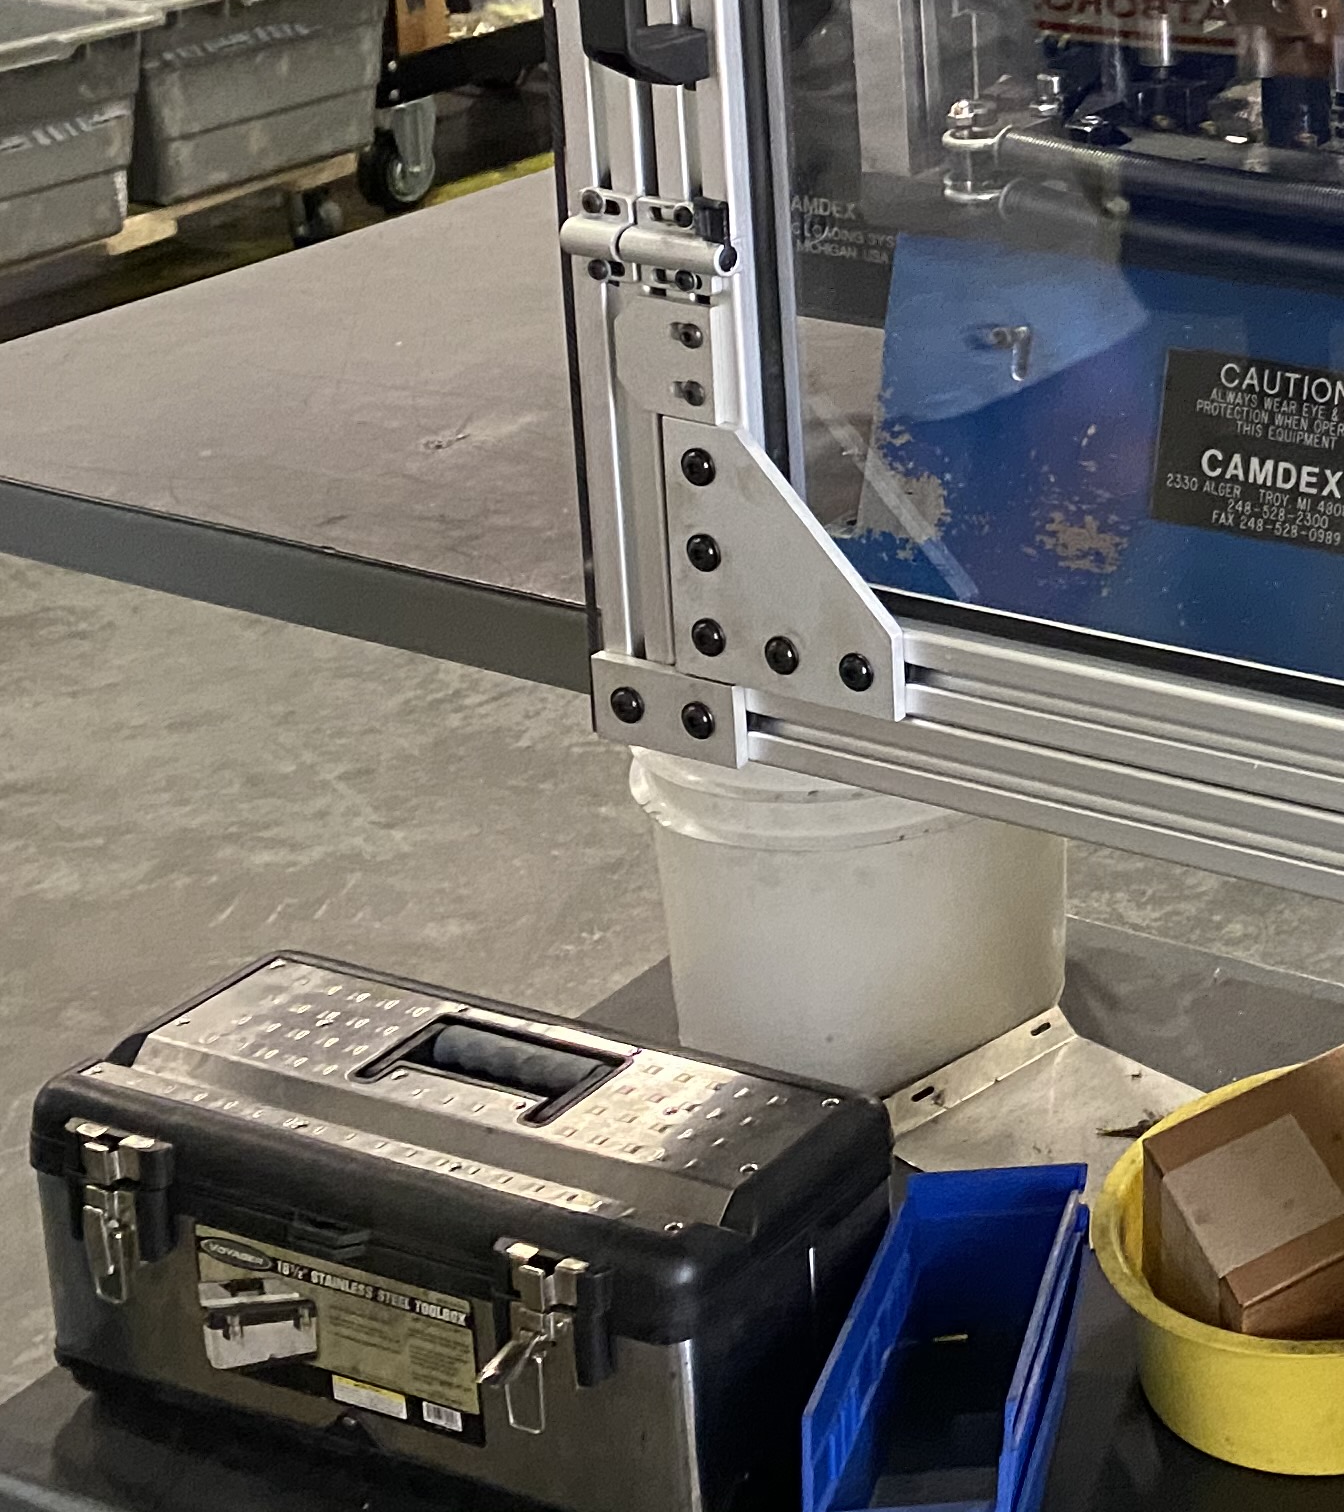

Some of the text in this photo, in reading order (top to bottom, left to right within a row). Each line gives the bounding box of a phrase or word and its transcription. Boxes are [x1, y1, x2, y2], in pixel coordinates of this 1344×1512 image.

[791, 194, 856, 220] AMDEX
[1196, 399, 1269, 425] PROTECTION
[1274, 411, 1309, 432] WHEN
[1209, 387, 1258, 409] ALWAYS
[1263, 394, 1296, 415] WEAR
[1301, 401, 1326, 420] EYE
[1331, 406, 1340, 423] &
[1236, 420, 1337, 451] THIS EQUIPMENT
[1166, 472, 1198, 493] 2330
[1202, 479, 1242, 500] ALGER
[1296, 494, 1311, 512] MI
[1211, 510, 1342, 546] FAX 248-528-0989
[1226, 498, 1329, 529] 248-528-2300
[310, 1270, 374, 1300] STAINLESS
[376, 1286, 410, 1311] STEEL
[414, 1299, 468, 1327] TOOLBOX
